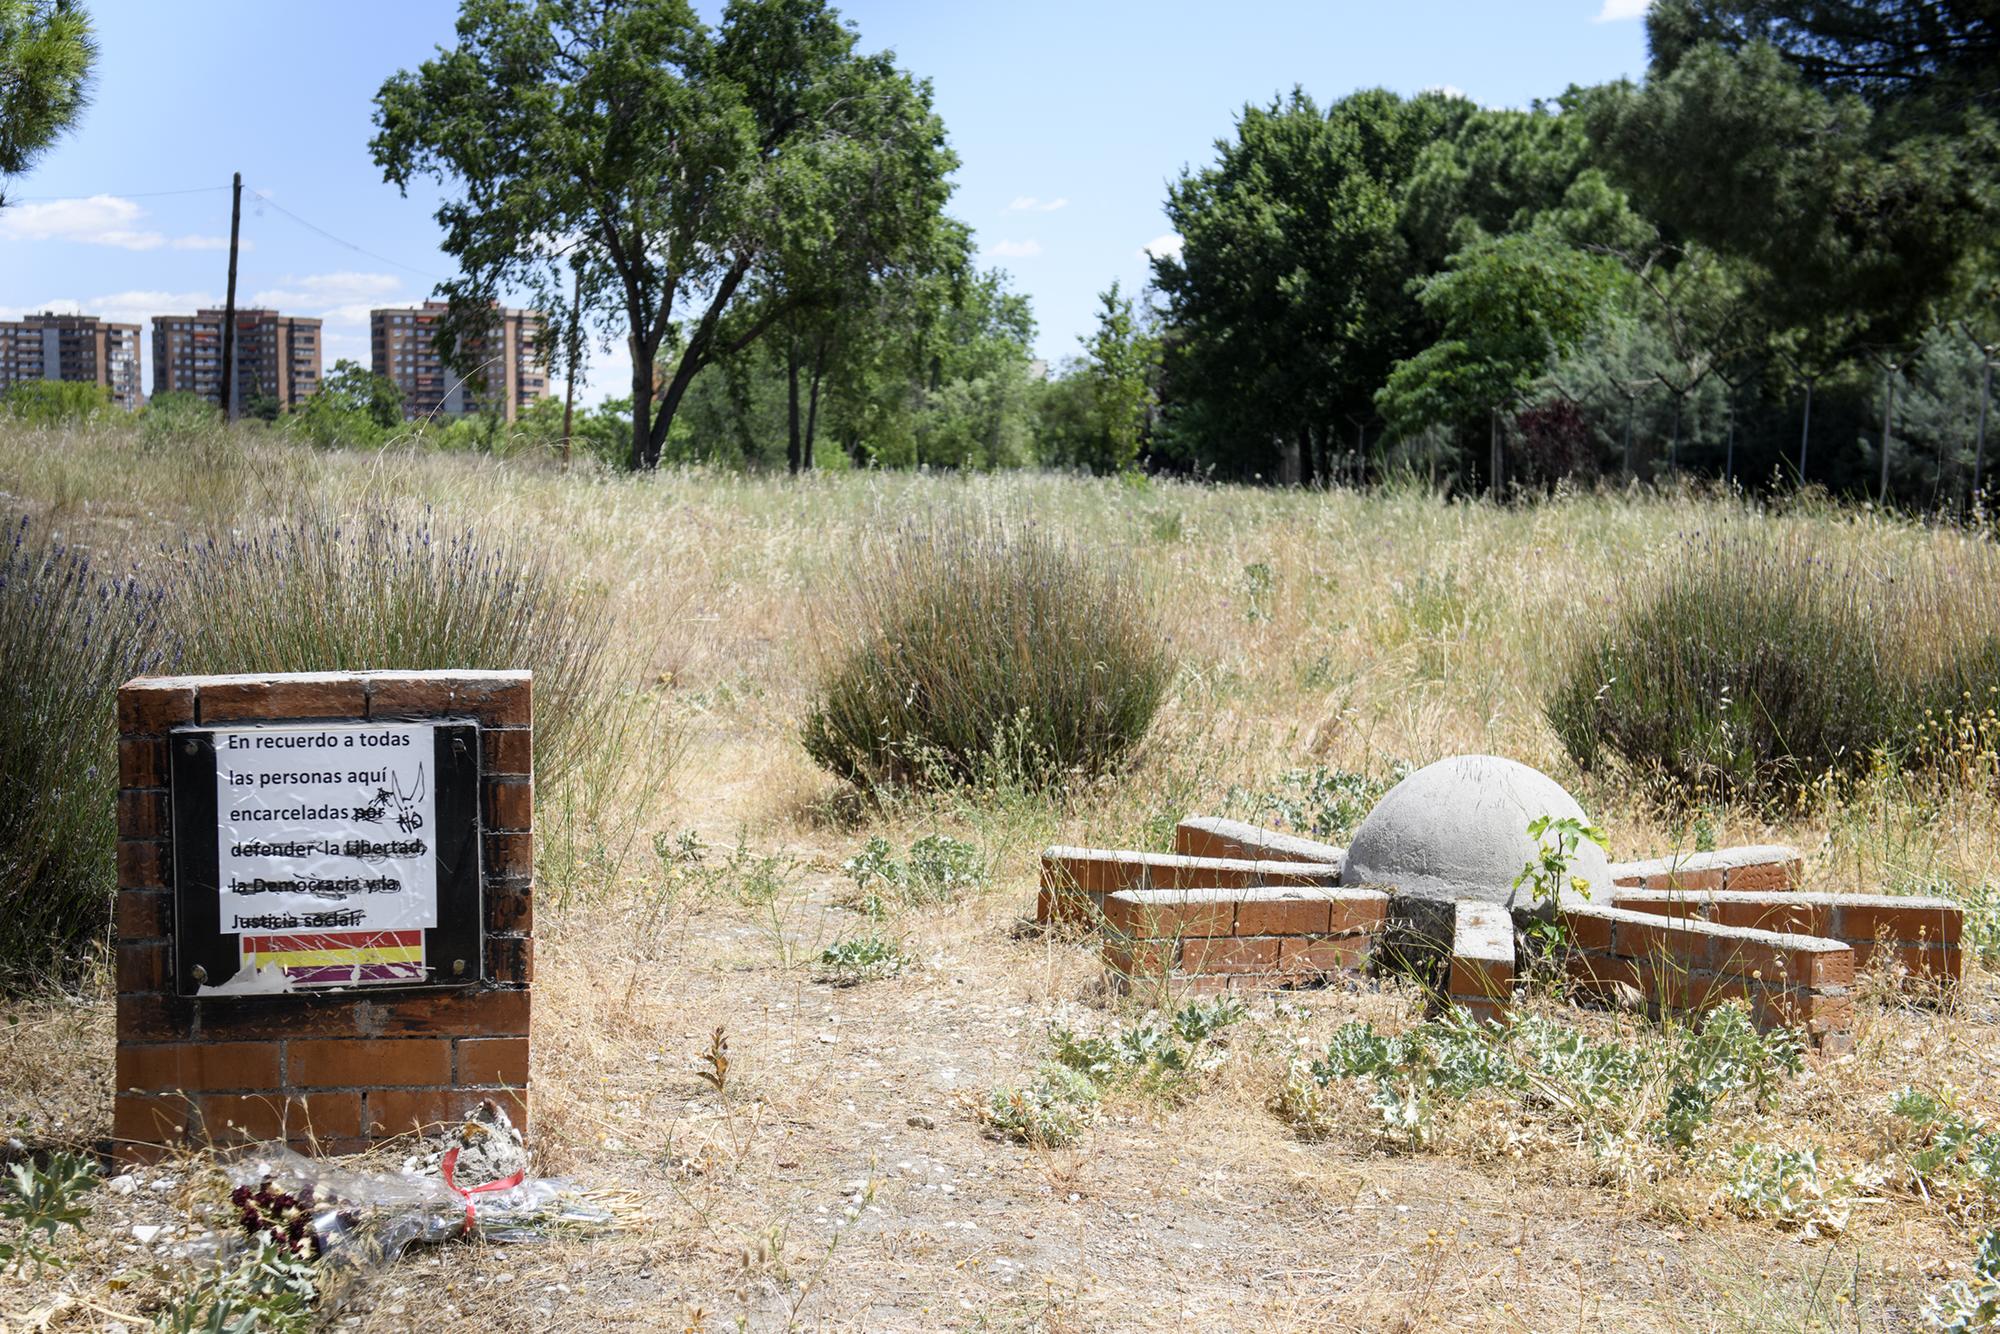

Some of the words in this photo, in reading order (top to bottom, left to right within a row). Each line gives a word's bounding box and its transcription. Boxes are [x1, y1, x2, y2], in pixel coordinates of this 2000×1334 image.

[229, 735, 249, 749] En
[256, 732, 338, 749] recuerdo
[344, 736, 354, 747] a
[360, 731, 410, 747] todas
[230, 770, 254, 785] las
[260, 771, 342, 787] personas
[347, 767, 388, 787] aquí
[230, 804, 349, 821] encarceladas
[353, 807, 384, 823] por
[231, 841, 315, 857] defender
[324, 840, 339, 855] la
[345, 838, 427, 856] Libertad,
[232, 877, 246, 893] la
[253, 875, 360, 893] Democracia
[365, 879, 375, 893] y
[381, 874, 397, 891] la
[231, 913, 299, 929] Justicia
